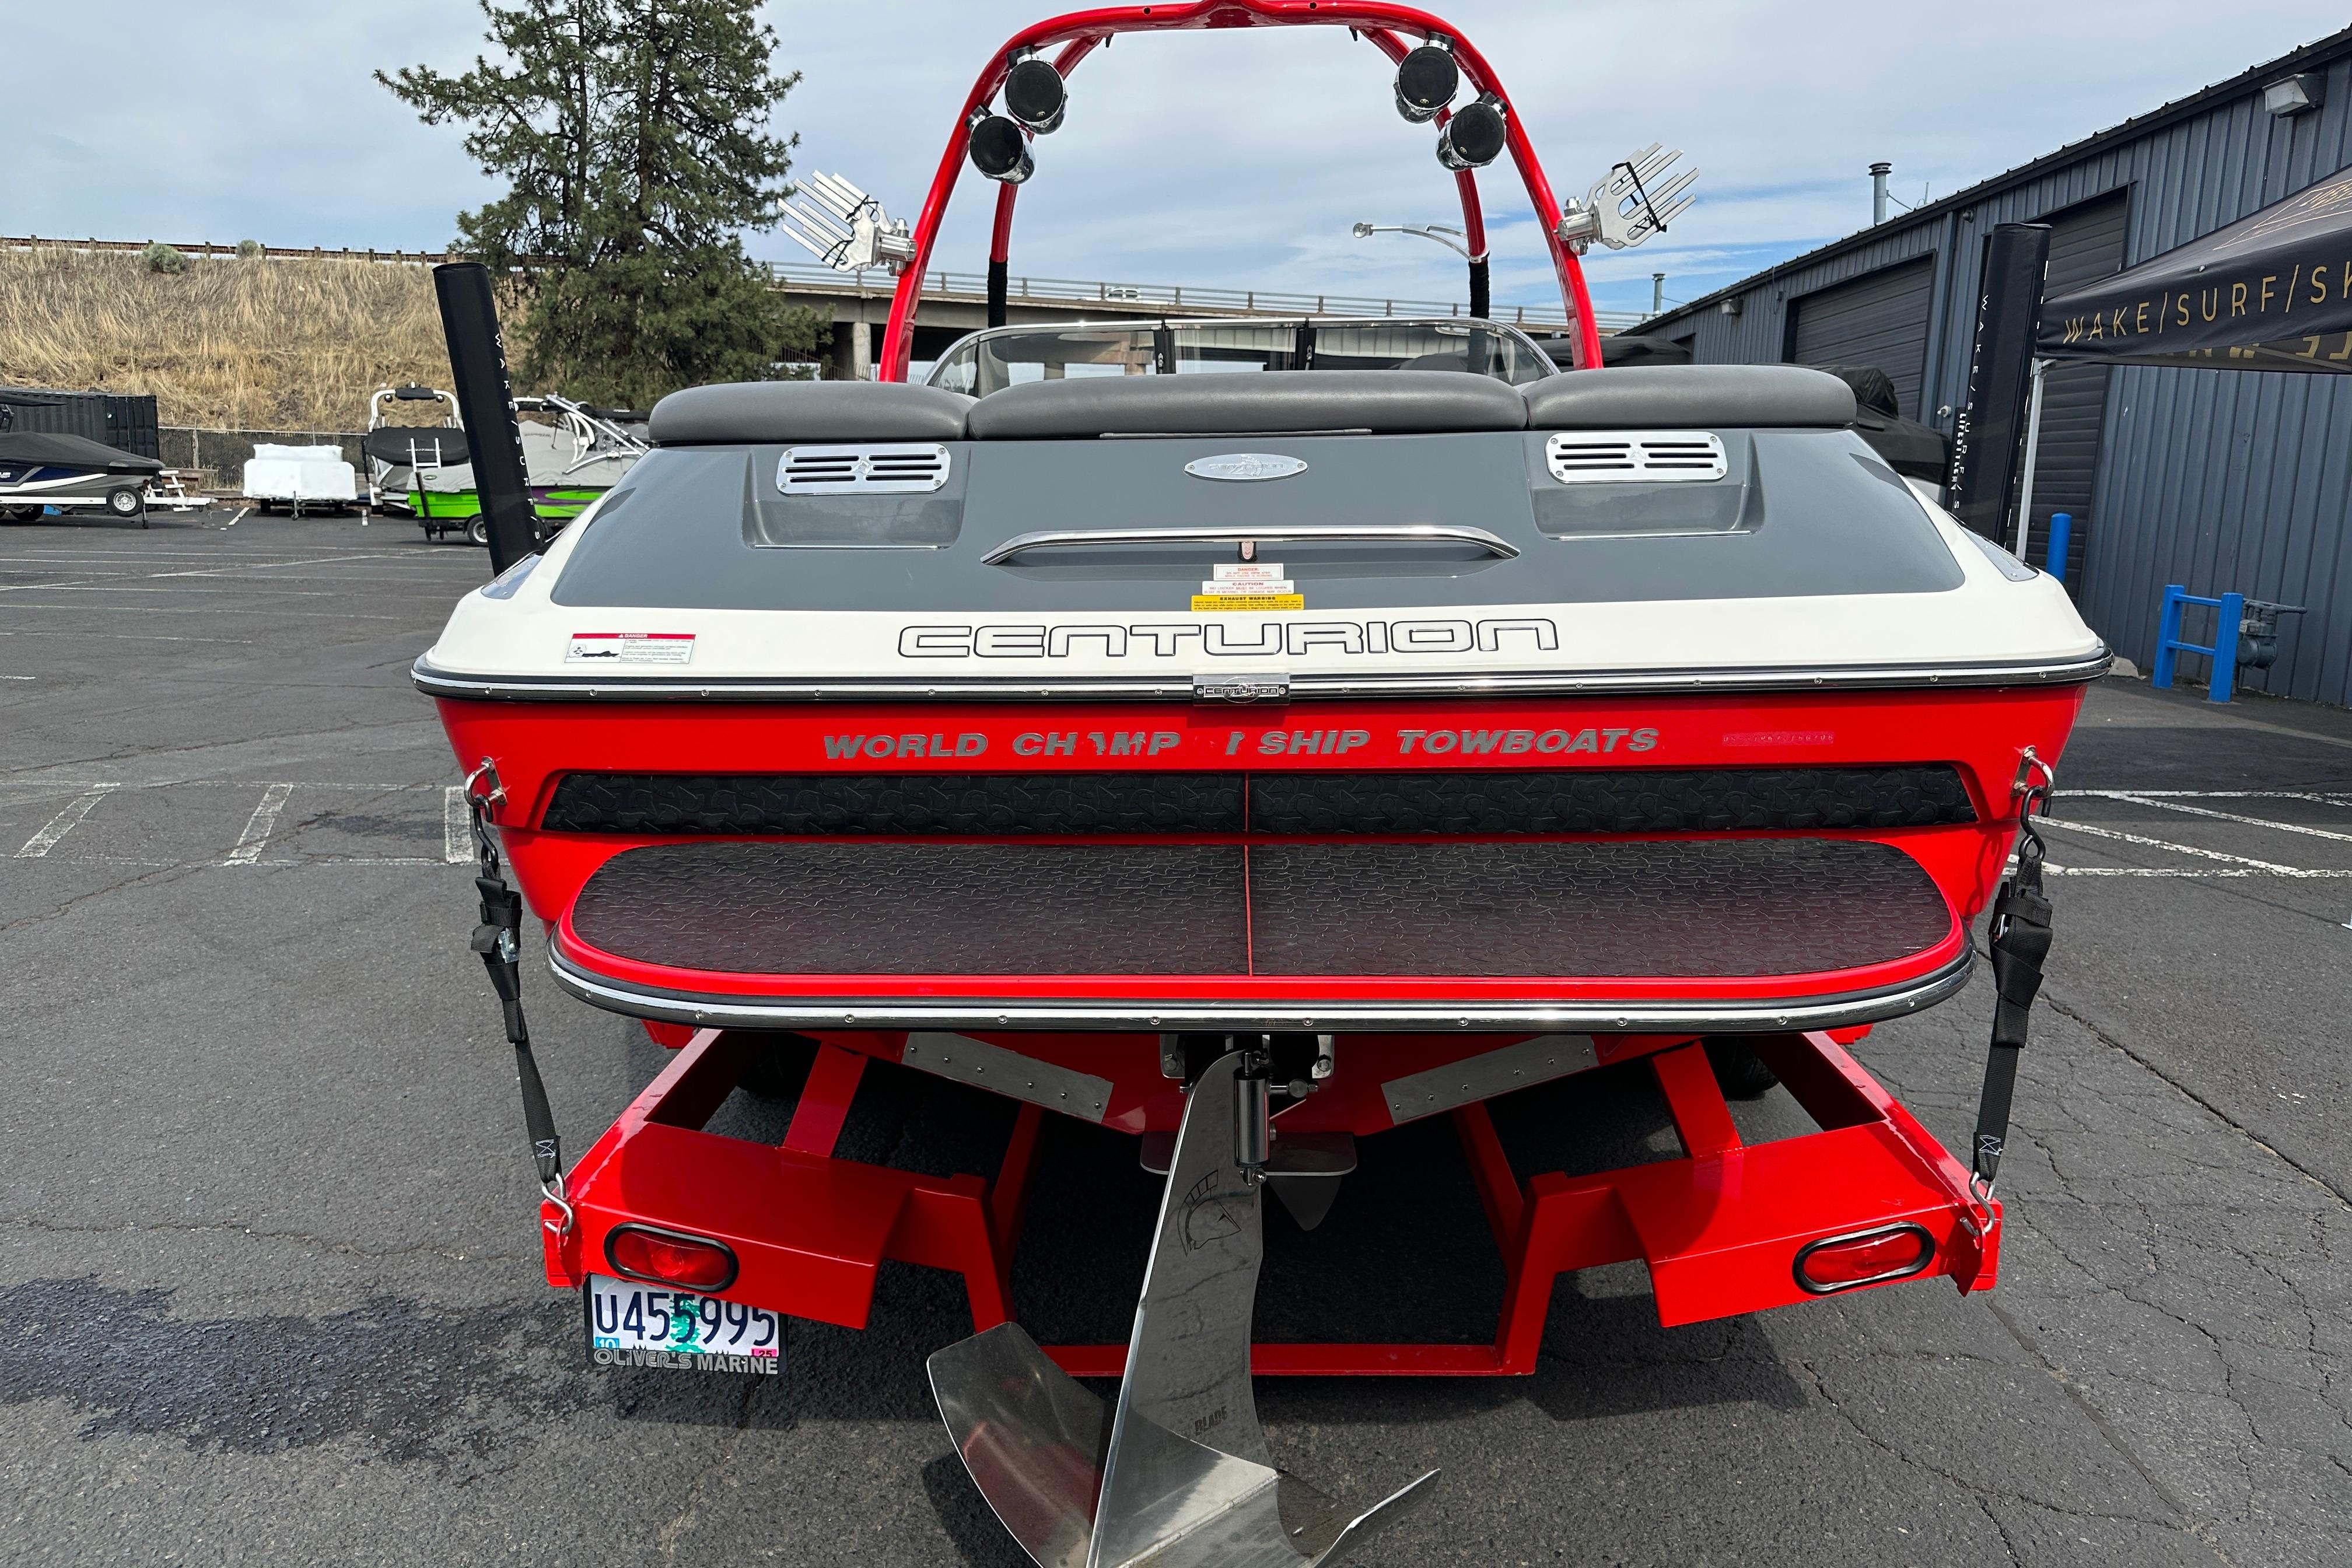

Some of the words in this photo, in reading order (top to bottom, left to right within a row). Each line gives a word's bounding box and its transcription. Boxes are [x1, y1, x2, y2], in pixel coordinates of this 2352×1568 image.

[898, 618, 1559, 657] CENTURION
[1205, 686, 1278, 695] CENTURION
[823, 733, 989, 759] WORLD
[1397, 728, 1660, 754] TOWBOATS
[595, 1291, 775, 1346] U455995
[697, 1353, 778, 1375] MARINE
[1194, 1405, 1228, 1437] BLADE
